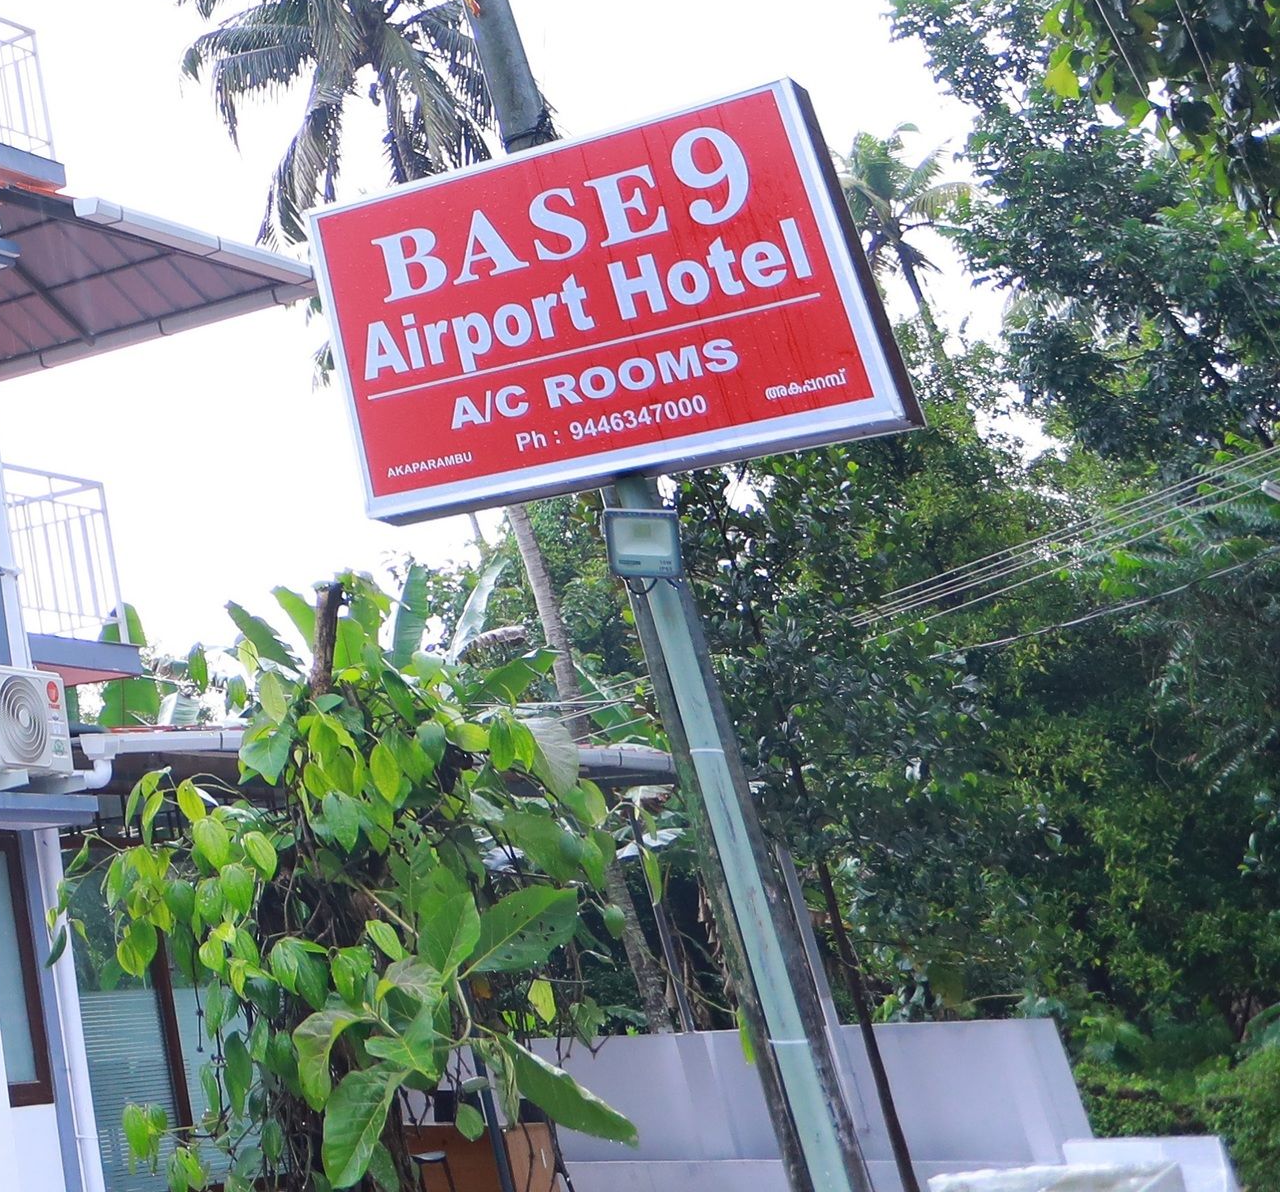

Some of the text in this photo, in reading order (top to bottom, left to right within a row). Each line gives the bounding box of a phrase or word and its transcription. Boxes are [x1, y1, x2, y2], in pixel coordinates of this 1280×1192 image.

[364, 217, 813, 381] Airport Hotel
[450, 338, 739, 430] A/C ROOMS
[765, 368, 847, 400] അകപ്പറമ്പ്
[569, 394, 707, 440] 9446347000
[386, 451, 473, 479] AKAPARAMBU
